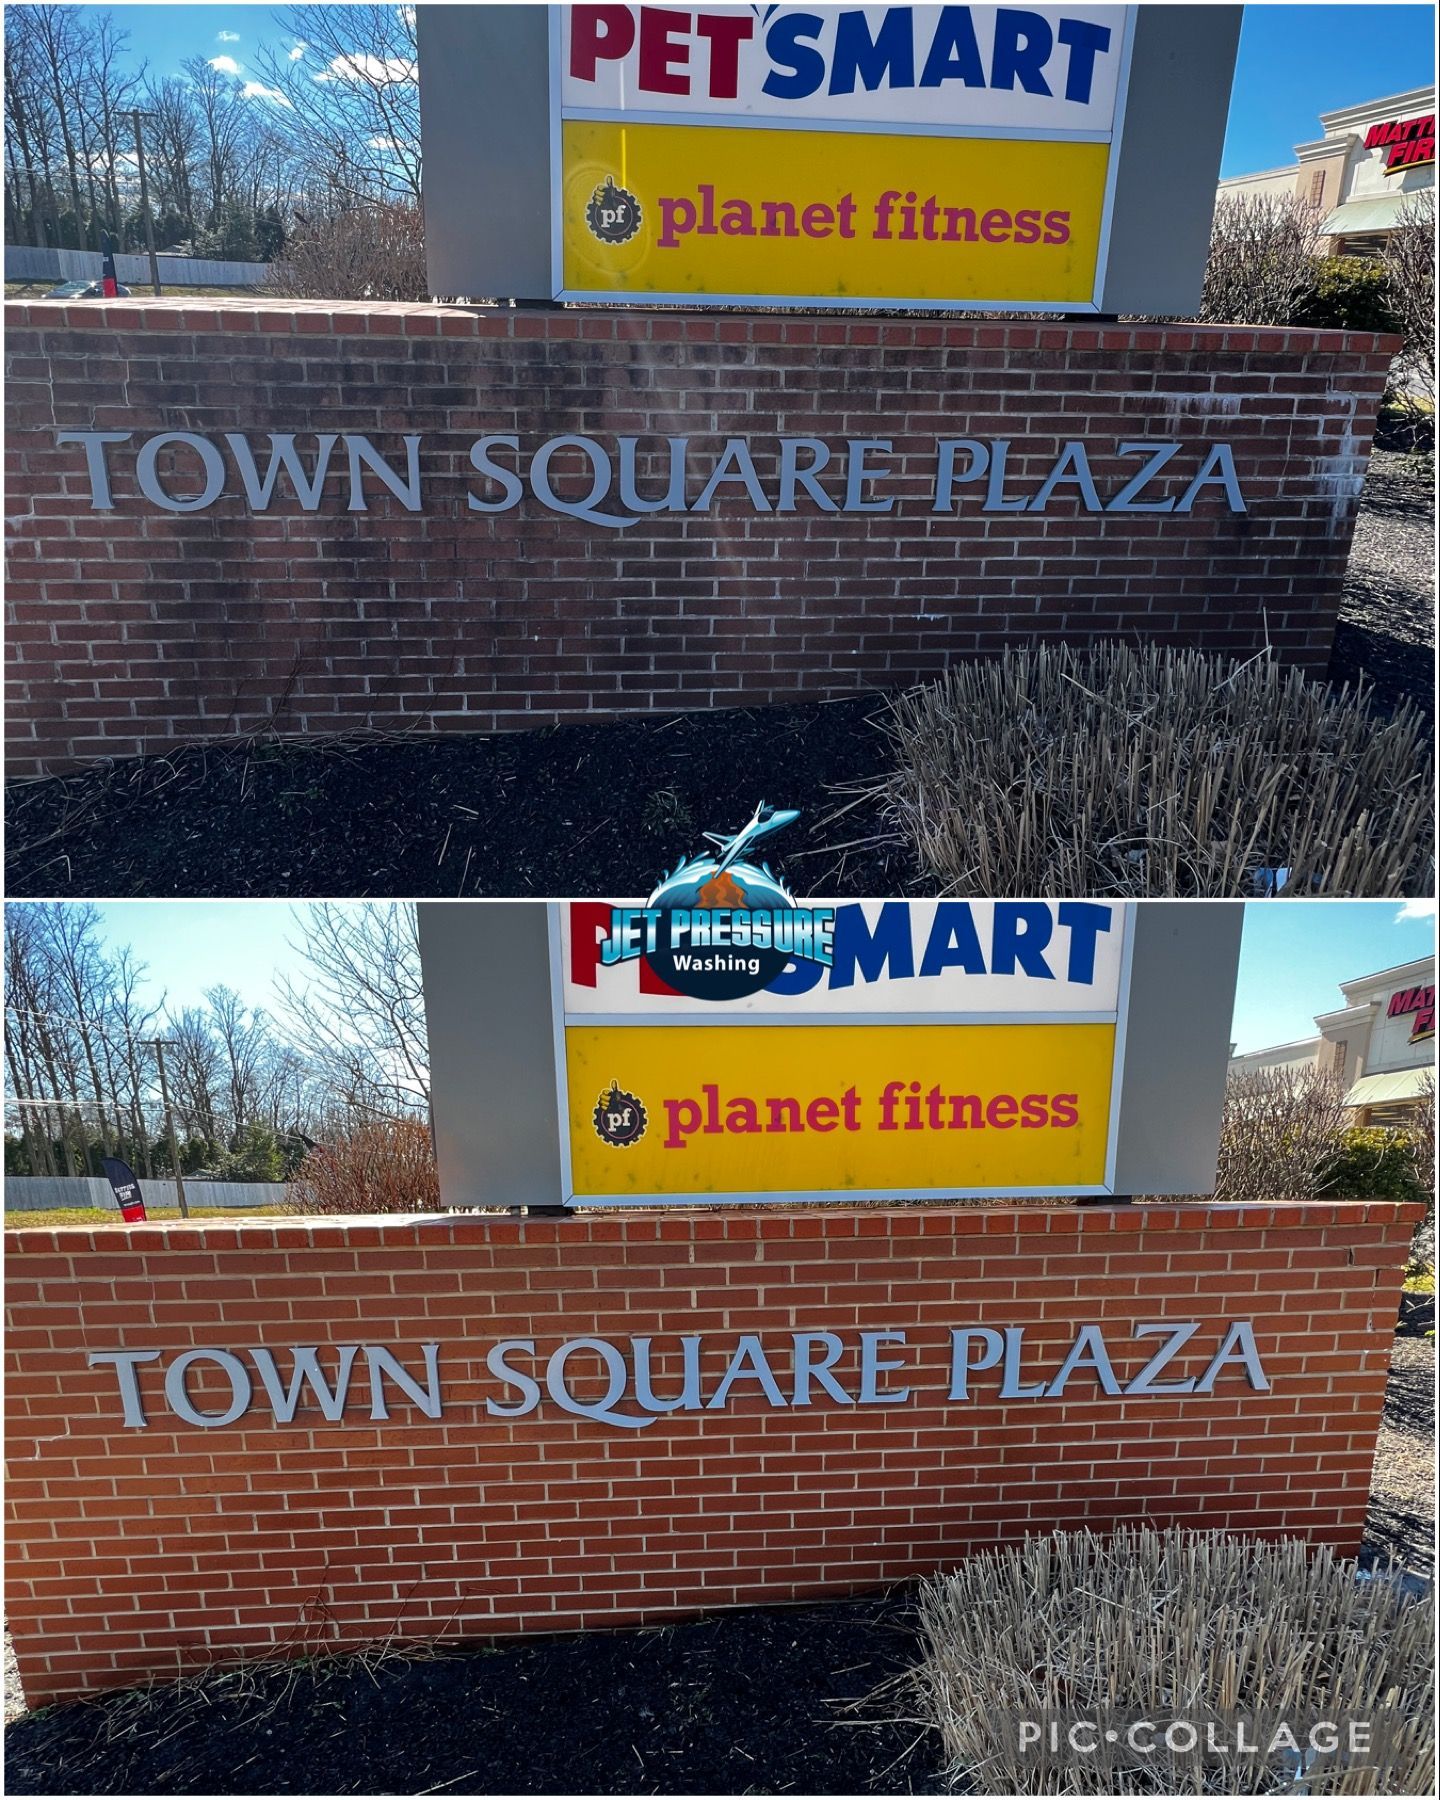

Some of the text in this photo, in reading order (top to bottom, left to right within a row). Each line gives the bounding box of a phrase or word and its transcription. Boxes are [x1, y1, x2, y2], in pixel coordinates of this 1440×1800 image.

[1387, 137, 1435, 168] FIR
[600, 203, 627, 228] pf
[656, 184, 1071, 248] planet fitness
[56, 431, 1248, 528] TOWN SQUARE PLAZA
[606, 1108, 632, 1132] pf
[663, 1080, 1079, 1149] planet fitness
[88, 1321, 1270, 1428] TOWN SQUARE PLAZA
